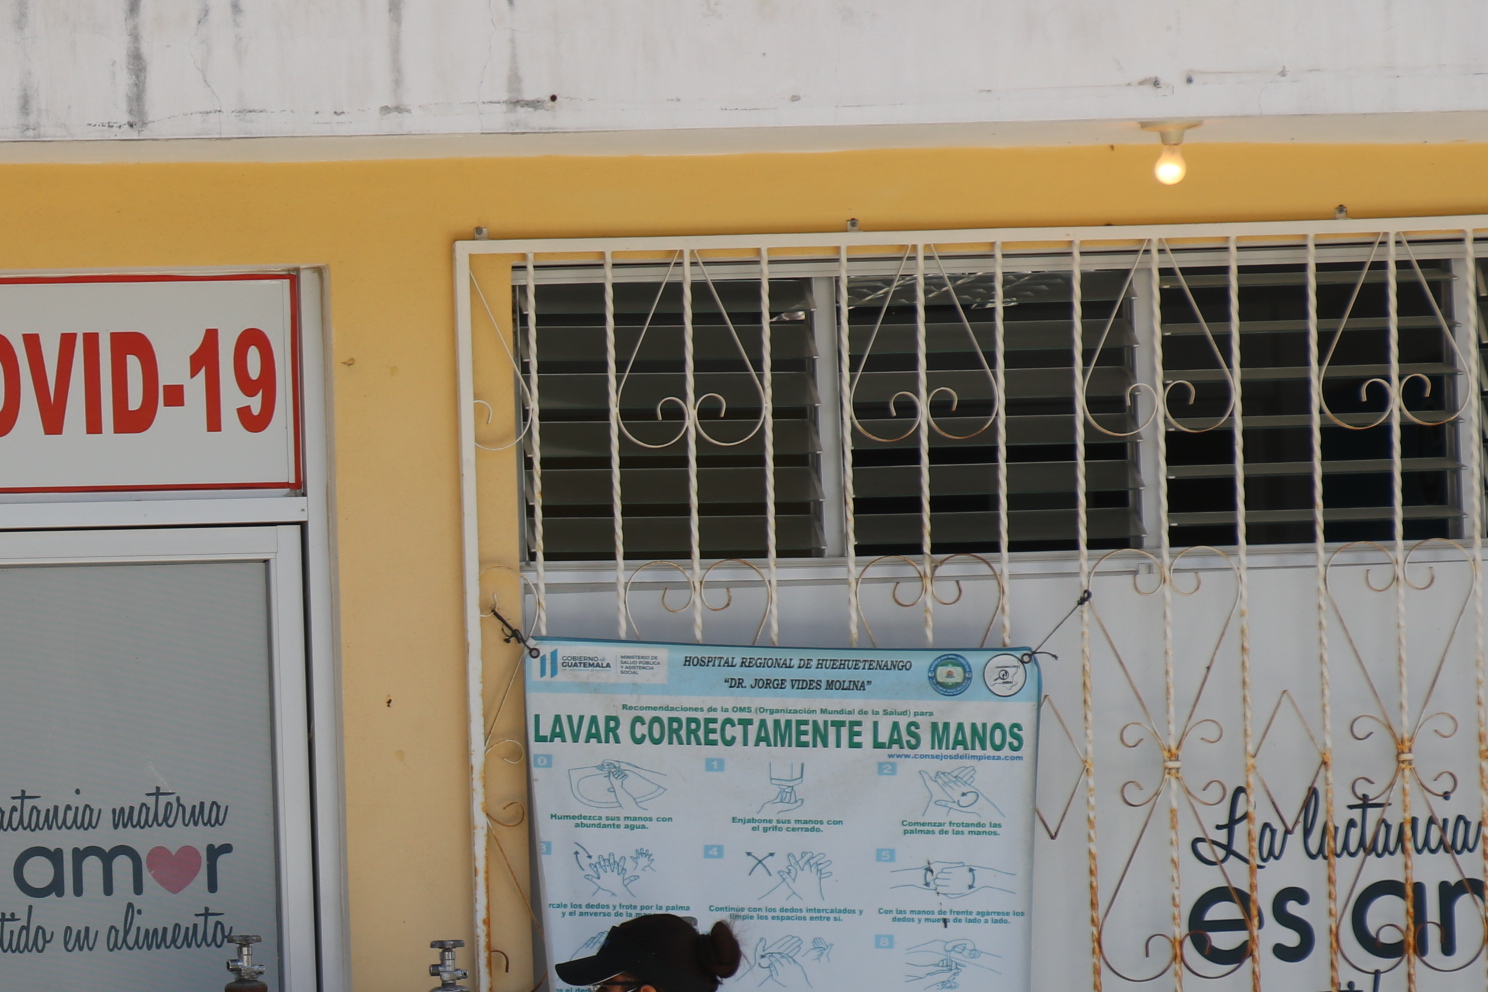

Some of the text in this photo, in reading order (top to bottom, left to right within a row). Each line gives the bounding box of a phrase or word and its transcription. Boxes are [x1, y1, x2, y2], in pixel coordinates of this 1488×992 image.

[683, 656, 912, 671] HOSPITAL REGIONAL DE HUEHUETENANGO
[750, 678, 822, 690] JORGE VIDES
[622, 703, 705, 713] Recomendaciones
[755, 706, 817, 716] (Organización
[820, 707, 856, 716] Mundial
[883, 709, 911, 717] Salud)
[534, 714, 1024, 752] LAVAR CORRECTAMENTE LAS MANOS
[888, 753, 1024, 761] www.consejosdelimpieza.com
[111, 785, 229, 831] materna
[550, 813, 602, 821] Humedezca
[732, 817, 773, 825] Enjabone
[903, 828, 936, 836] palmas
[1190, 785, 1289, 870] La
[709, 905, 745, 913] Continúe
[976, 909, 1011, 917] agárrese
[771, 914, 807, 922] espacios
[62, 924, 99, 953] en
[106, 901, 233, 952] alimento
[1188, 886, 1316, 966] es
